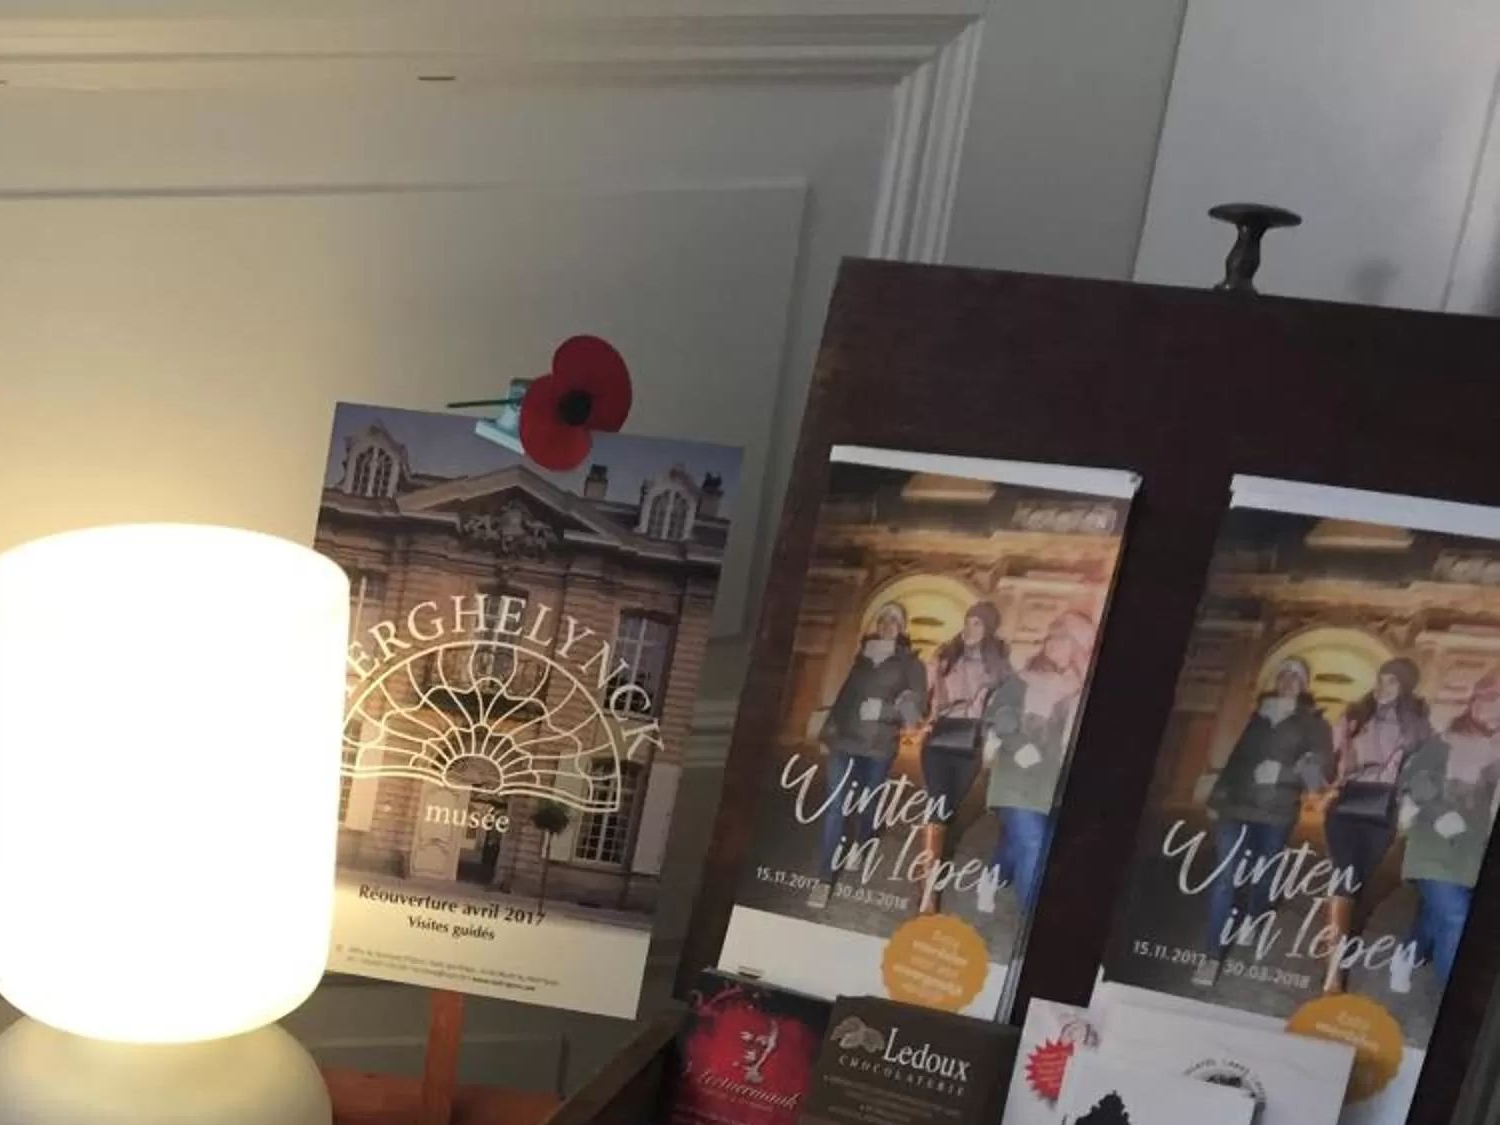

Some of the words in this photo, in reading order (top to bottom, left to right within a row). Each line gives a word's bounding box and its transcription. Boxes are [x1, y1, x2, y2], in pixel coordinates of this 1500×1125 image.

[345, 593, 663, 758] ERGHELYNCK
[425, 801, 509, 832] musée
[359, 884, 457, 913] Réouverture
[462, 902, 499, 919] avril
[504, 906, 546, 926] 2017
[408, 915, 449, 933] Visites
[452, 921, 494, 940] guidés
[882, 1027, 971, 1083] Ledoux
